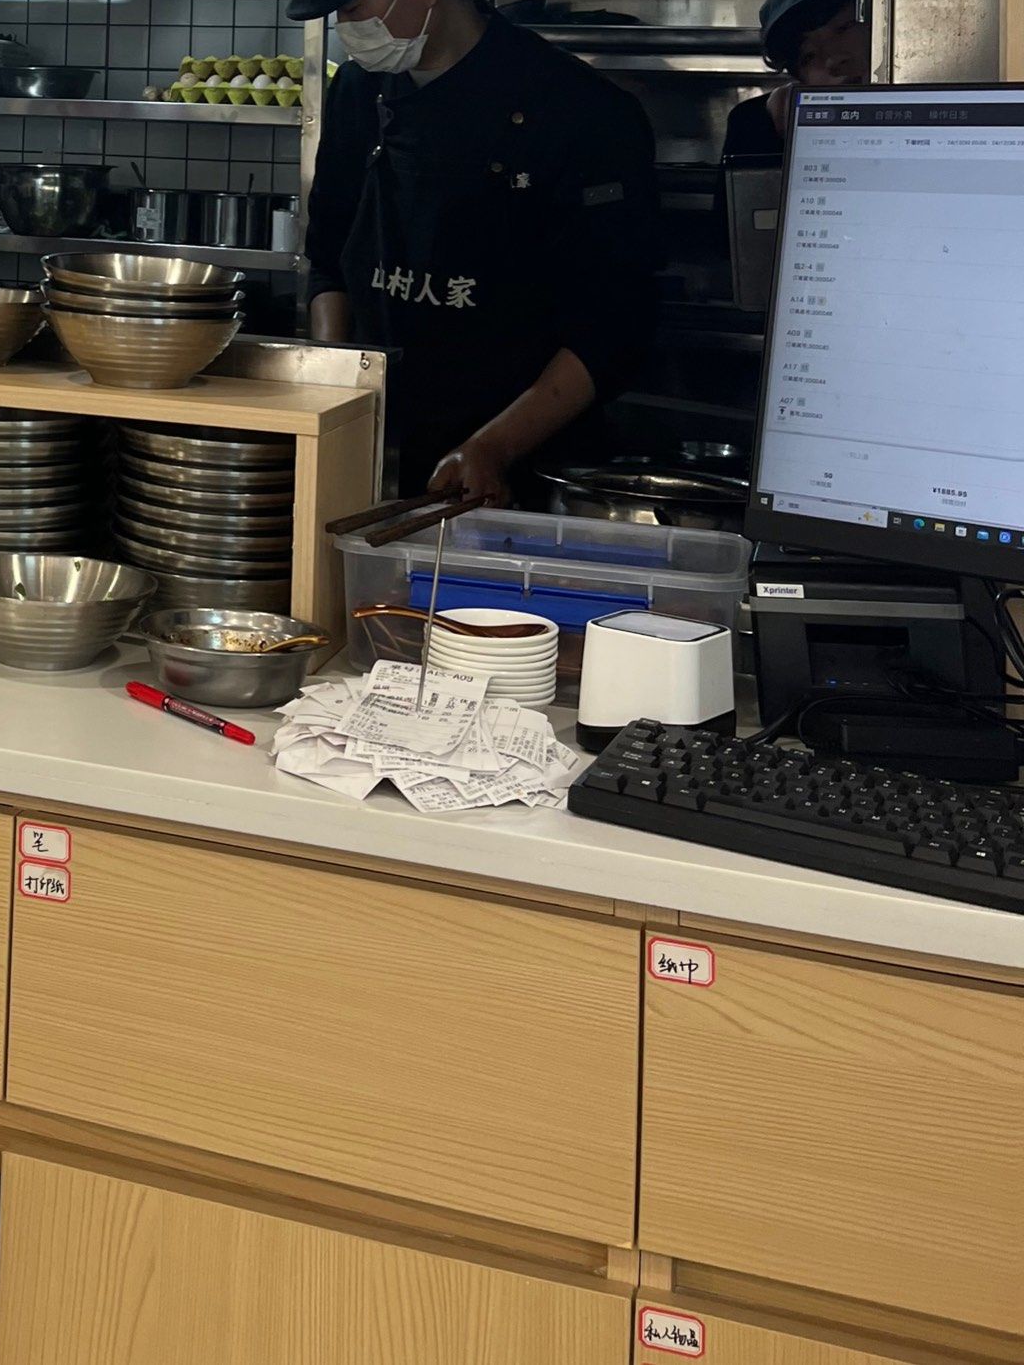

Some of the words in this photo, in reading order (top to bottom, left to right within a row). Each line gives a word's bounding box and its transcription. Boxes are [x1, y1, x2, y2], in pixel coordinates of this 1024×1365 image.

[840, 111, 860, 121] 店内
[763, 586, 798, 596] Xprinter
[32, 831, 49, 852] 笔
[25, 876, 64, 895] 打印纸
[658, 953, 699, 984] 纸巾
[644, 1318, 700, 1348] 私人物品
